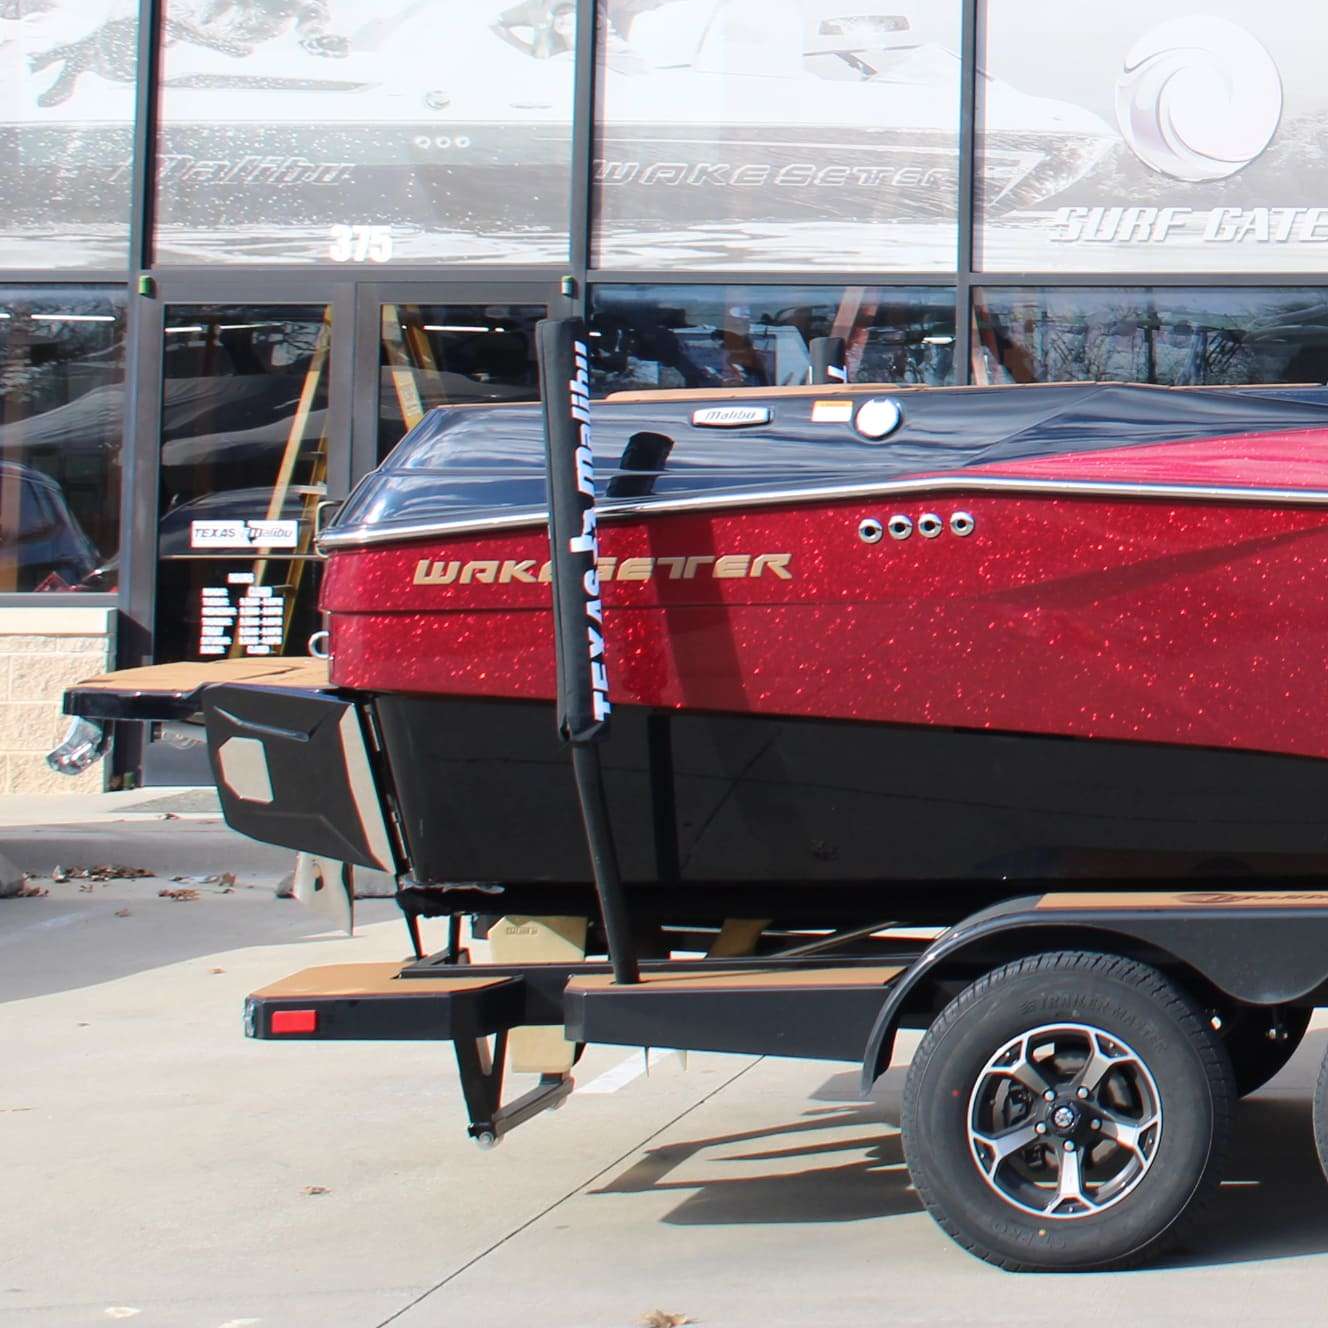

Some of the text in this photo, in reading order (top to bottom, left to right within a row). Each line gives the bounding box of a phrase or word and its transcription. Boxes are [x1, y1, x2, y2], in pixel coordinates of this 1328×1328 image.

[1051, 207, 1193, 242] SURF
[329, 224, 393, 263] 375
[704, 410, 756, 421] Malibu
[194, 528, 237, 538] TEXAS
[412, 553, 792, 586] WAKETTER
